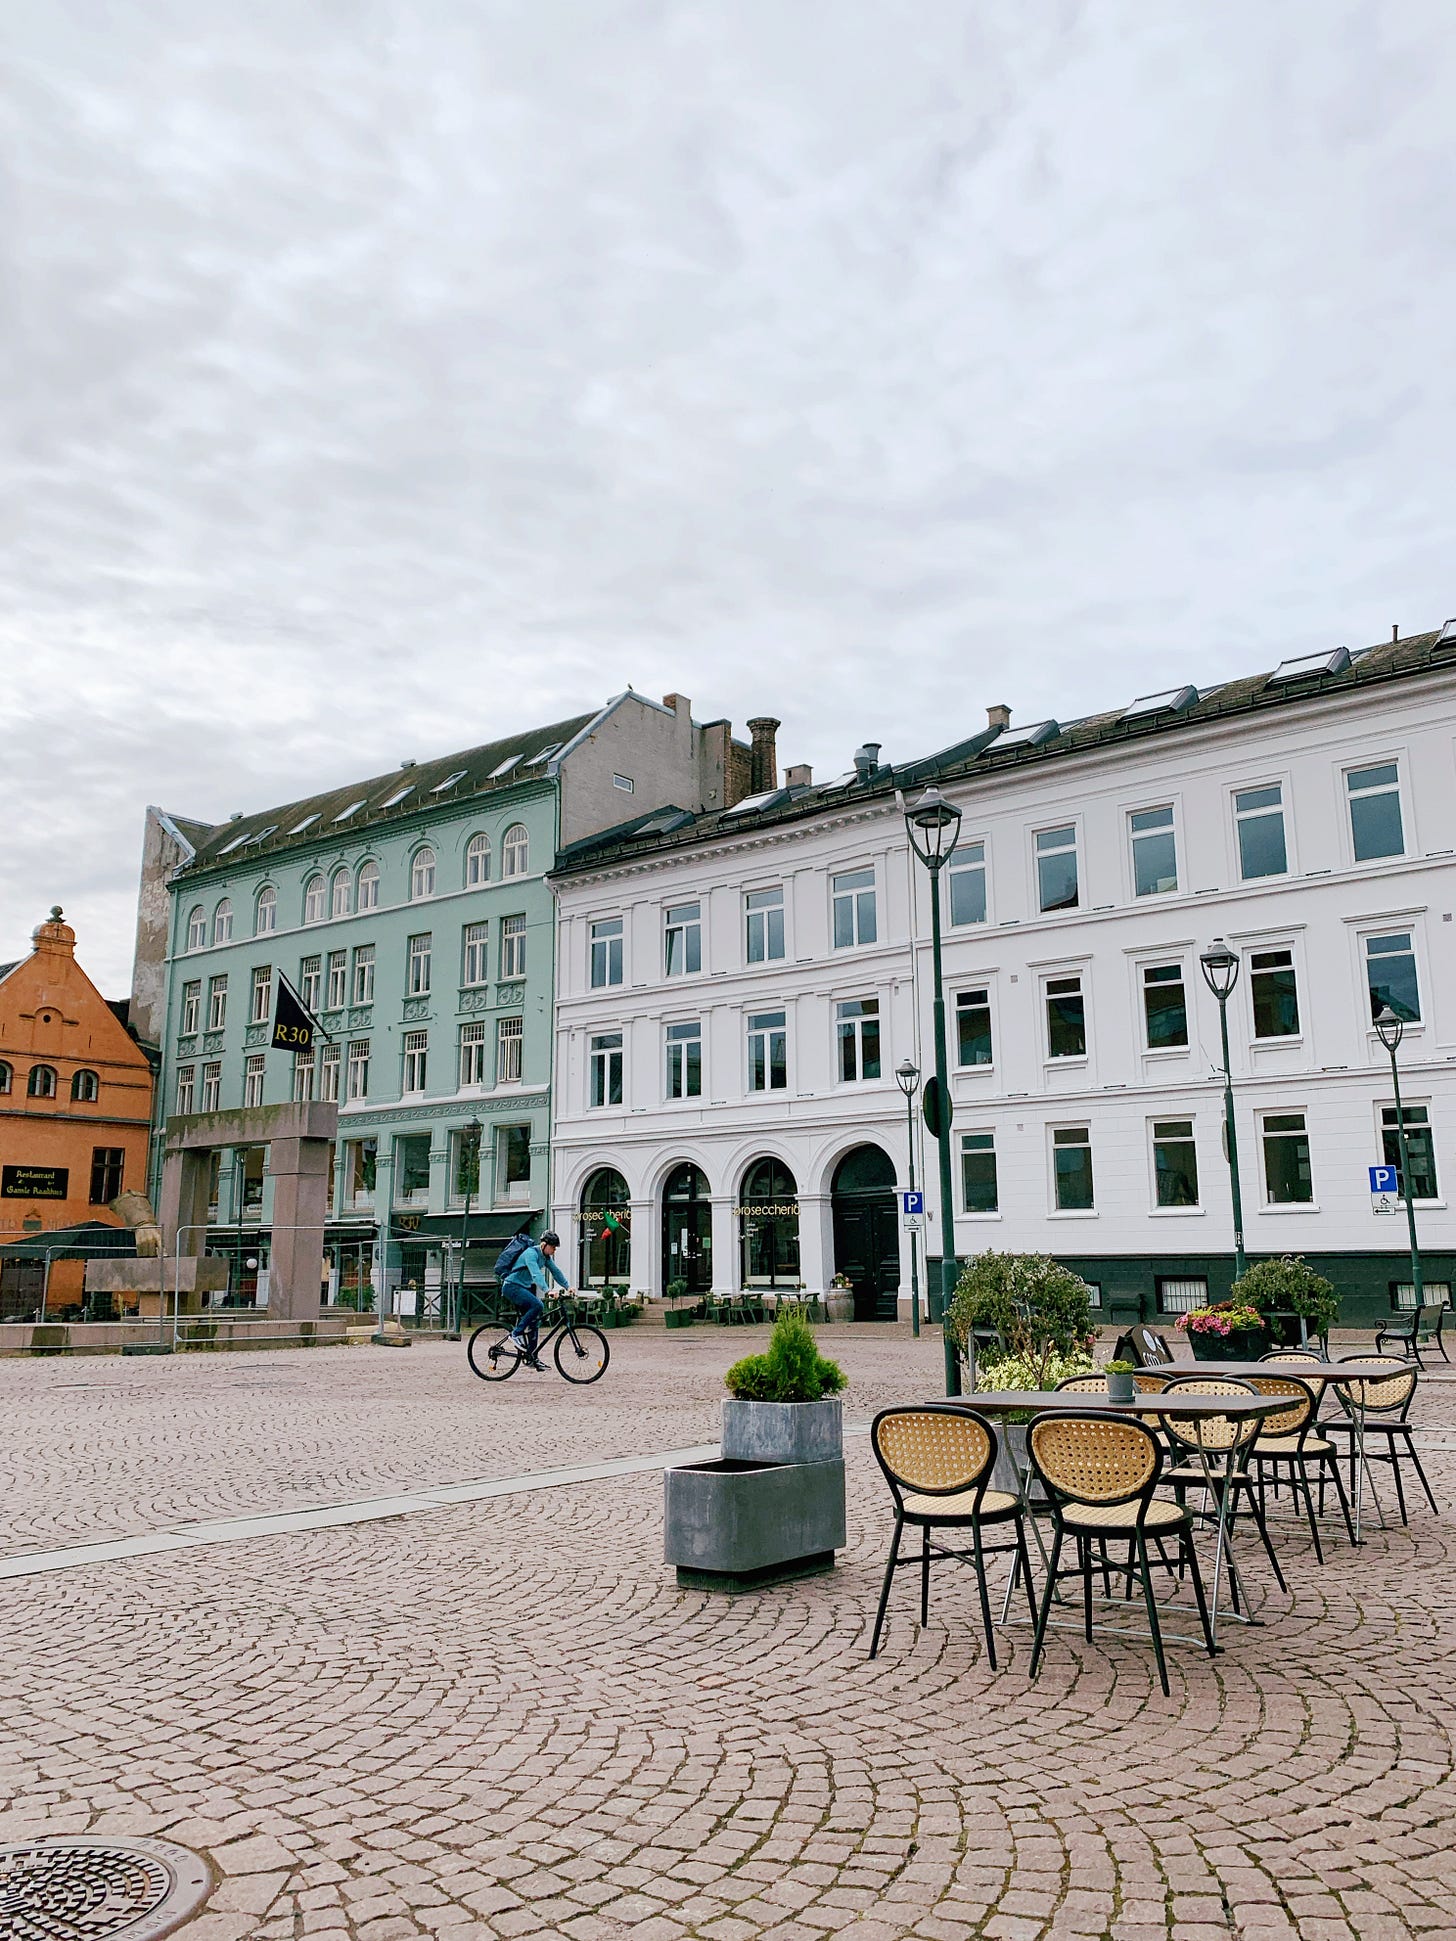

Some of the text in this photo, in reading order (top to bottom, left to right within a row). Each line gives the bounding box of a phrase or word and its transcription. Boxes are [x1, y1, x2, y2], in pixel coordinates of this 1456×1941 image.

[275, 1023, 309, 1045] R30
[1375, 1169, 1390, 1190] P
[908, 1194, 919, 1212] P
